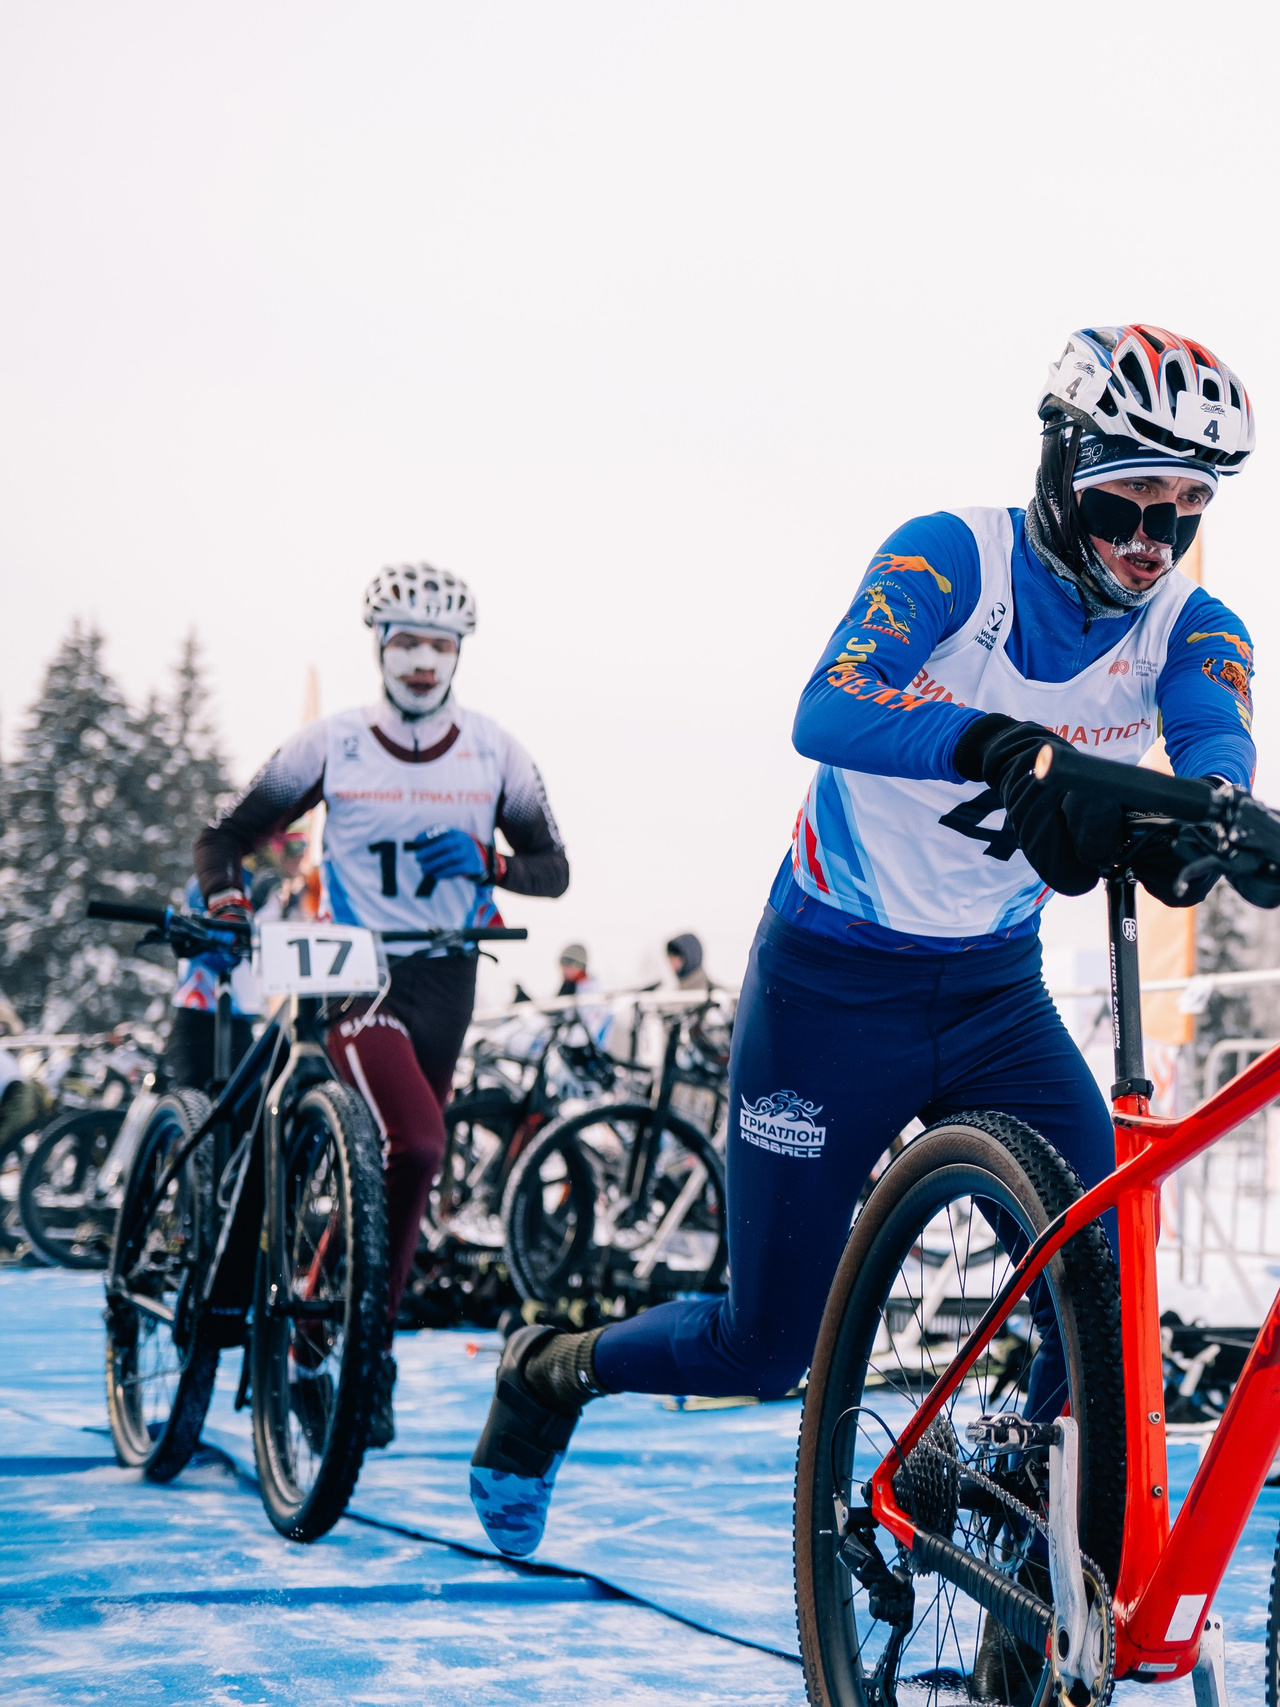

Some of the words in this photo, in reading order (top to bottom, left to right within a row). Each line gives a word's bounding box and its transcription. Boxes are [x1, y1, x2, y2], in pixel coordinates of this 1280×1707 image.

[1065, 376, 1083, 400] 4
[1203, 419, 1220, 443] 4
[974, 635, 995, 651] riathlo
[980, 629, 998, 644] World
[938, 787, 1021, 862] 4
[287, 937, 353, 977] 17
[1109, 941, 1118, 993] RITCHEY
[1113, 995, 1121, 1050] CARBON
[740, 1128, 822, 1159] КУЗБАСС
[742, 1112, 823, 1144] ТРИАТЛОН
